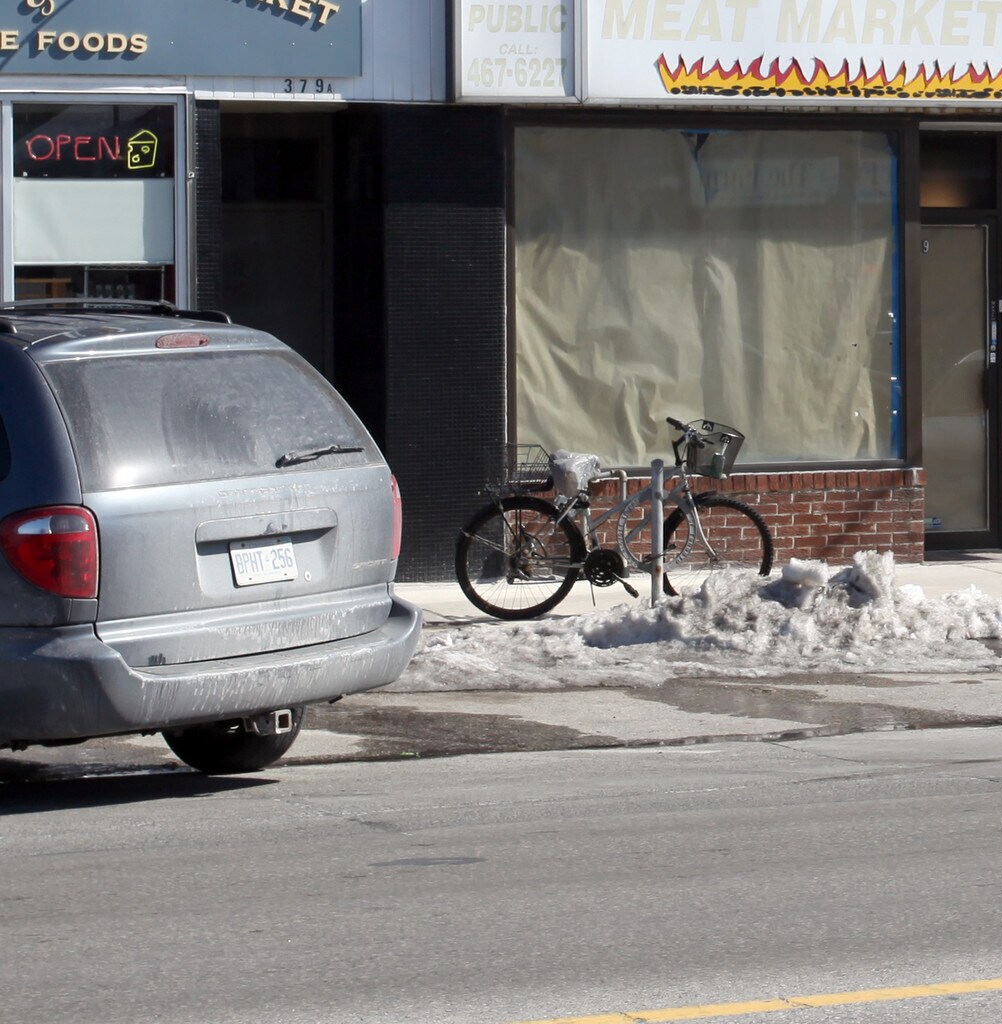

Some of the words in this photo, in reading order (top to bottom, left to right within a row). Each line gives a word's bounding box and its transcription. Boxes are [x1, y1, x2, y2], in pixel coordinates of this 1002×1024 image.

[467, 4, 567, 34] PUBLIC
[38, 31, 150, 54] FOODS
[467, 57, 568, 88] 467-6227
[26, 134, 121, 161] OPEN
[270, 548, 294, 570] 256
